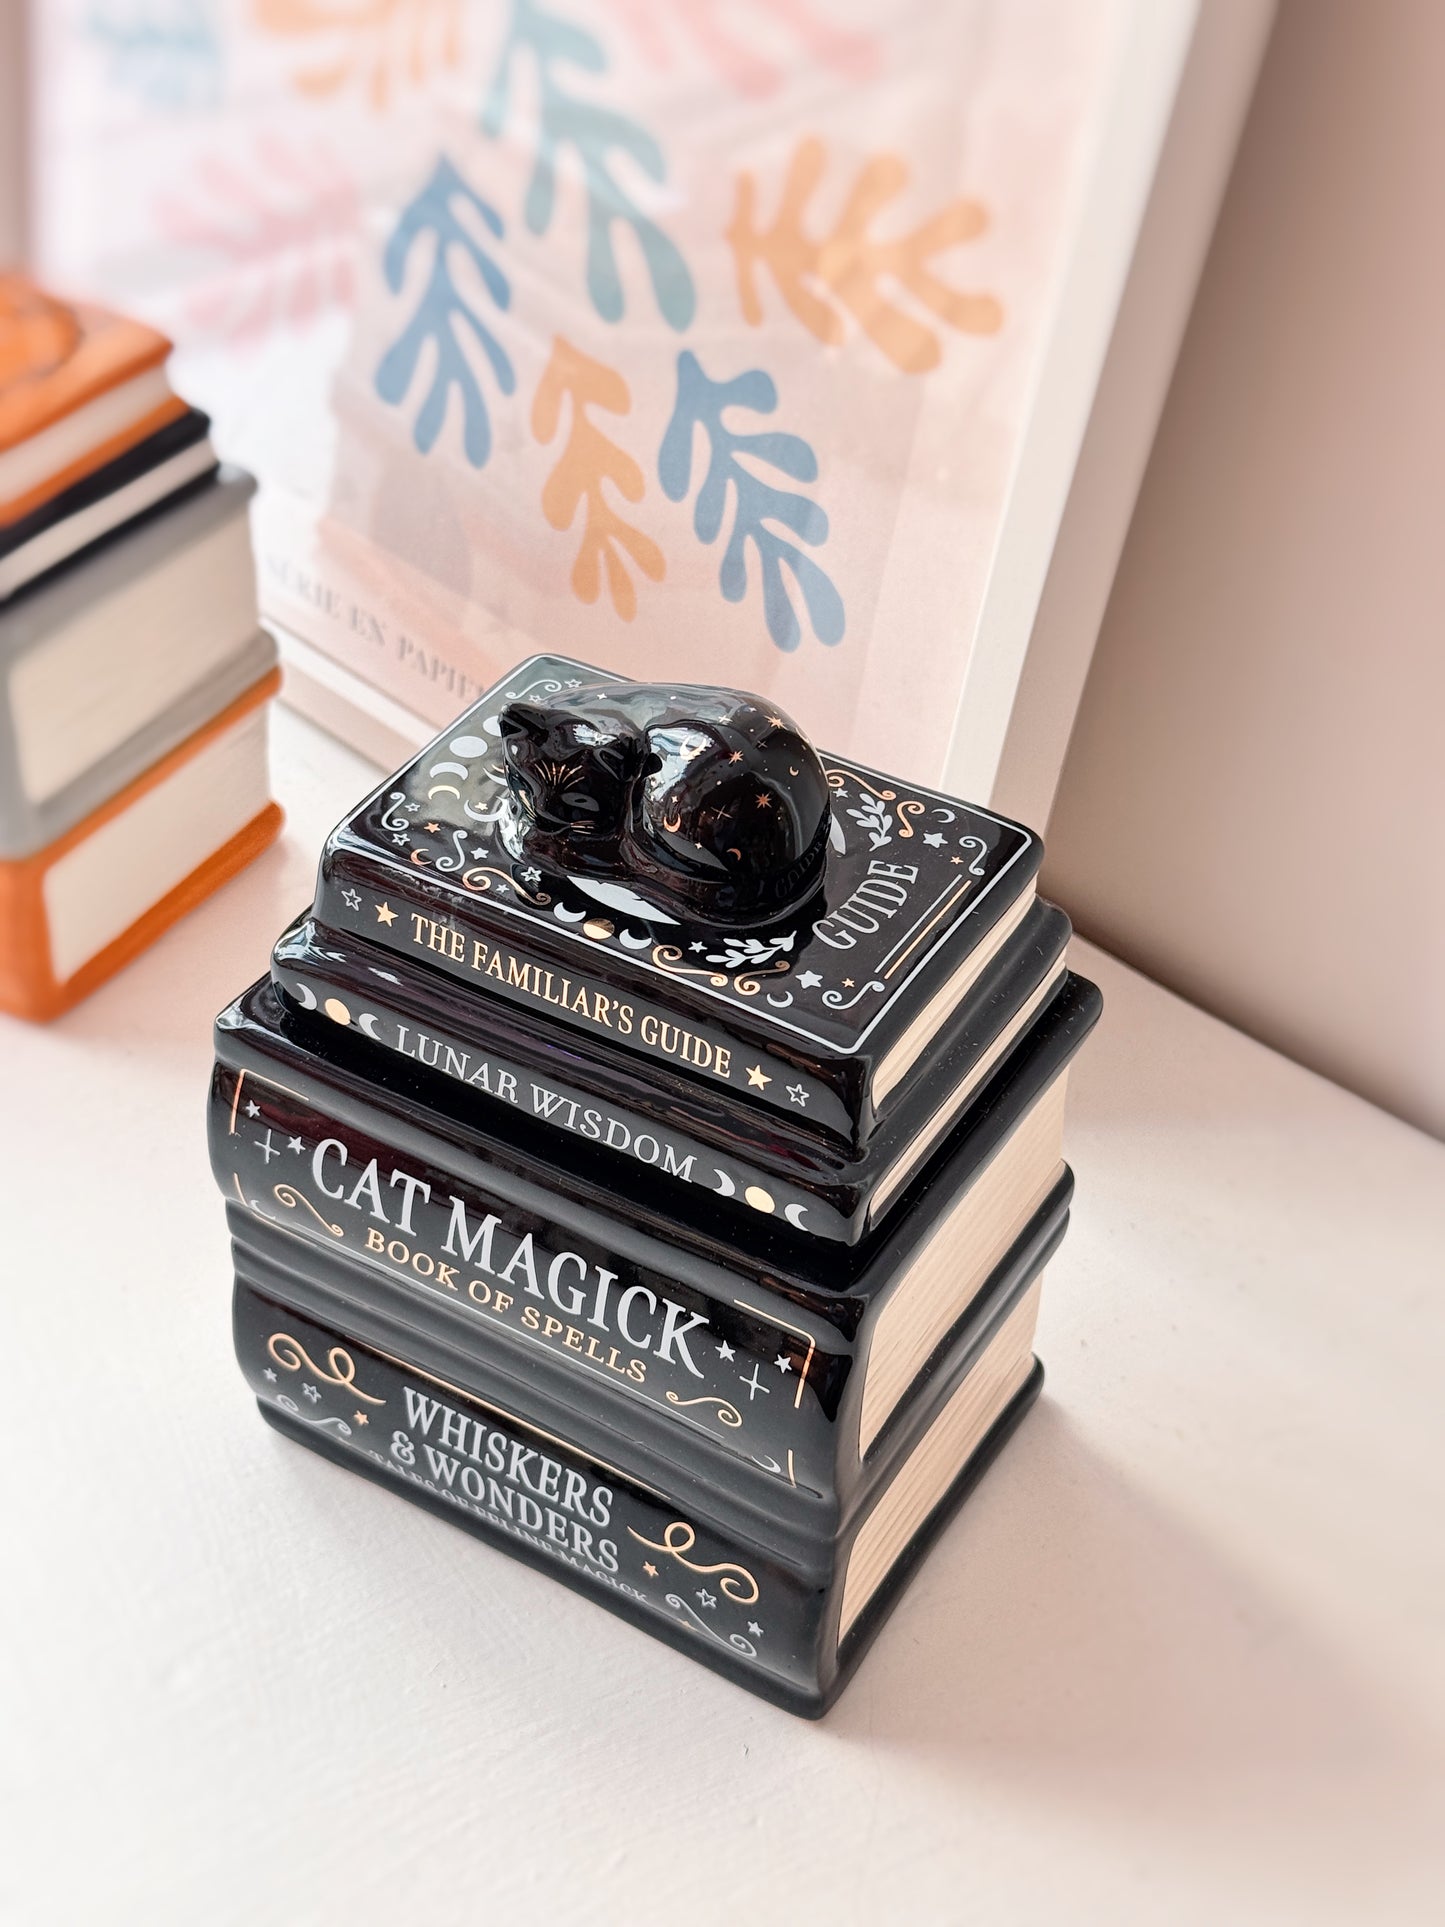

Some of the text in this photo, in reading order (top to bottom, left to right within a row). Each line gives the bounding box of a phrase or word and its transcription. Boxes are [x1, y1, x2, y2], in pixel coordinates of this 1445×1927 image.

[350, 604, 387, 647] EN
[812, 860, 919, 949] GUIDE
[410, 912, 732, 1079] THE FAMILIAR'S GUIDE
[395, 1024, 698, 1184] LUNAR WISDOM
[312, 1138, 710, 1379] CAT MAGICK
[364, 1227, 648, 1383] BOOK OF SPELLS
[390, 1430, 619, 1572] & WONDERS
[404, 1386, 614, 1528] WHISKERS
[558, 1549, 649, 1604] MAGICK
